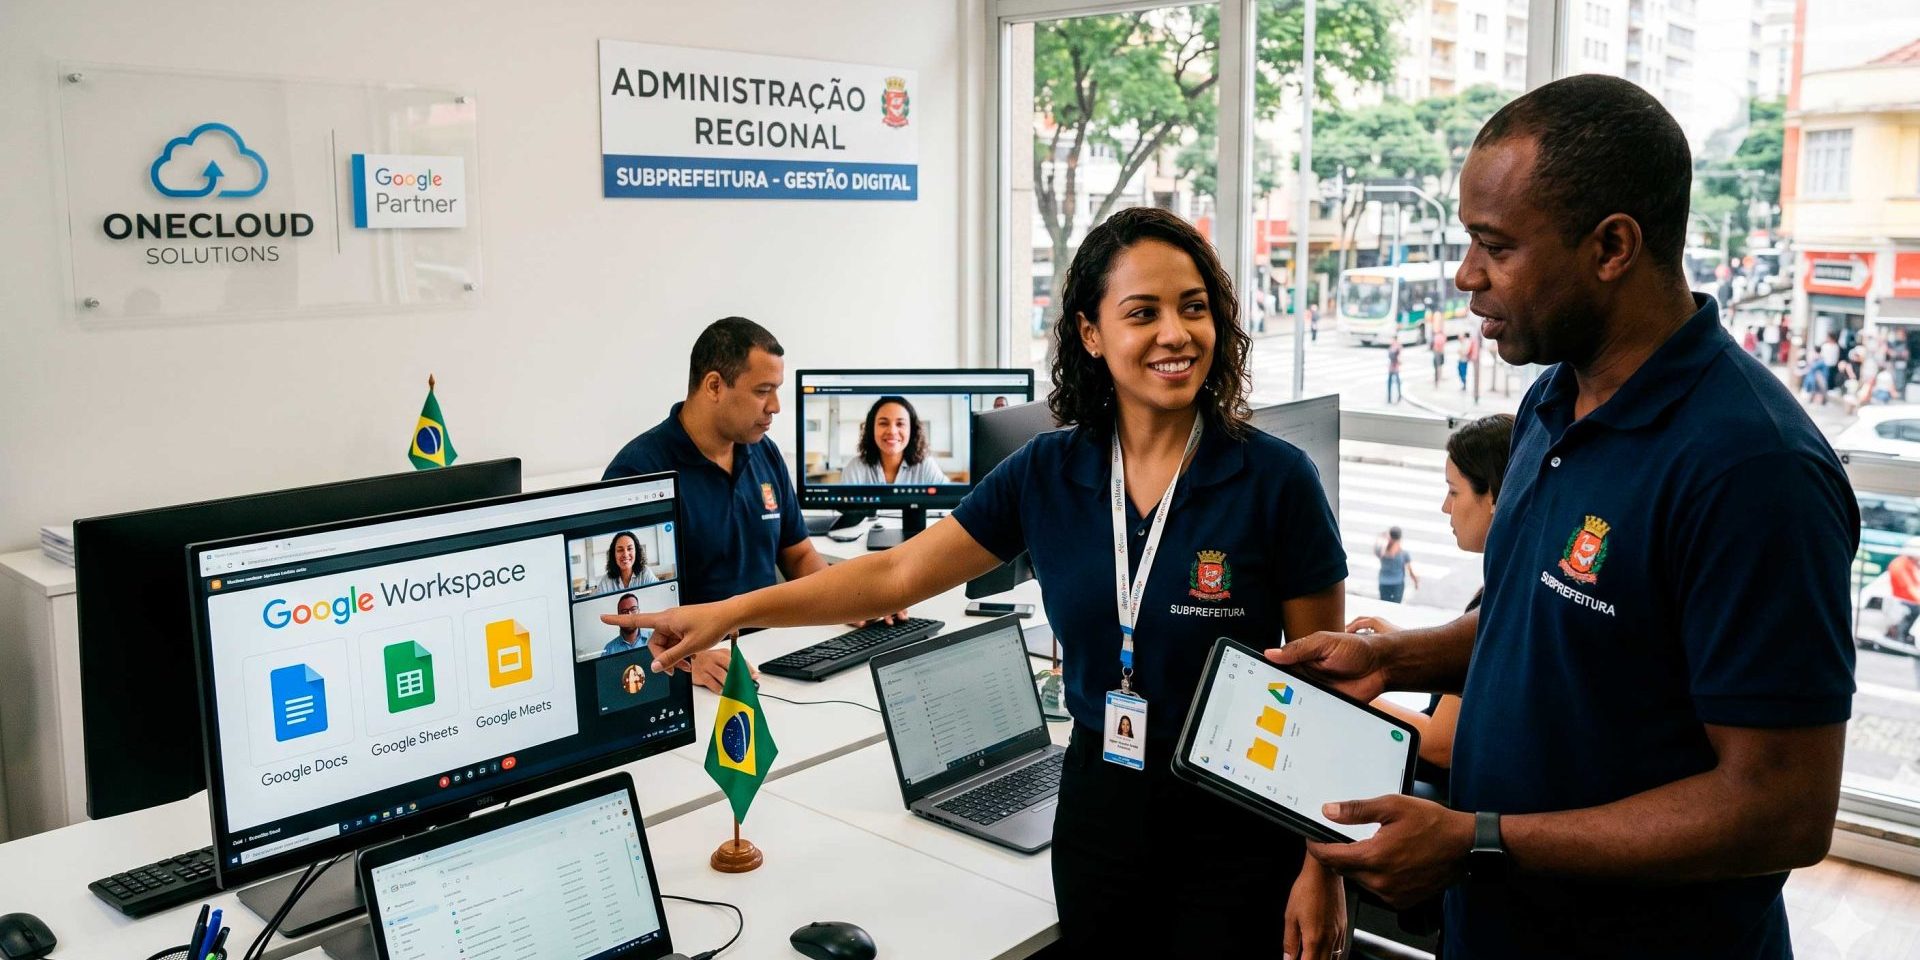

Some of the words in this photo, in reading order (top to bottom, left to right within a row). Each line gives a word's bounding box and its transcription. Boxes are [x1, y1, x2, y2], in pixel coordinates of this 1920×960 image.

[611, 67, 866, 114] ADMINISTRAÇÃO
[695, 117, 846, 151] REGIONAL
[375, 167, 442, 191] Google
[616, 167, 768, 190] SUBPREFEITURA
[784, 168, 849, 191] GESTÃO
[852, 172, 912, 192] DIGITAL
[376, 192, 457, 215] Partner
[103, 212, 314, 240] ONECLOUD
[146, 245, 280, 265] SOLUTIONS
[263, 585, 374, 629] Google
[380, 563, 526, 607] Workspace
[1540, 570, 1616, 617] SUBPREFEITURA
[1170, 604, 1245, 618] SUBPREFEITURA
[476, 708, 517, 728] Google
[519, 700, 552, 718] Meets
[371, 736, 416, 757] Google
[419, 725, 459, 744] Sheets
[261, 763, 312, 787] Google
[315, 754, 348, 773] Docs
